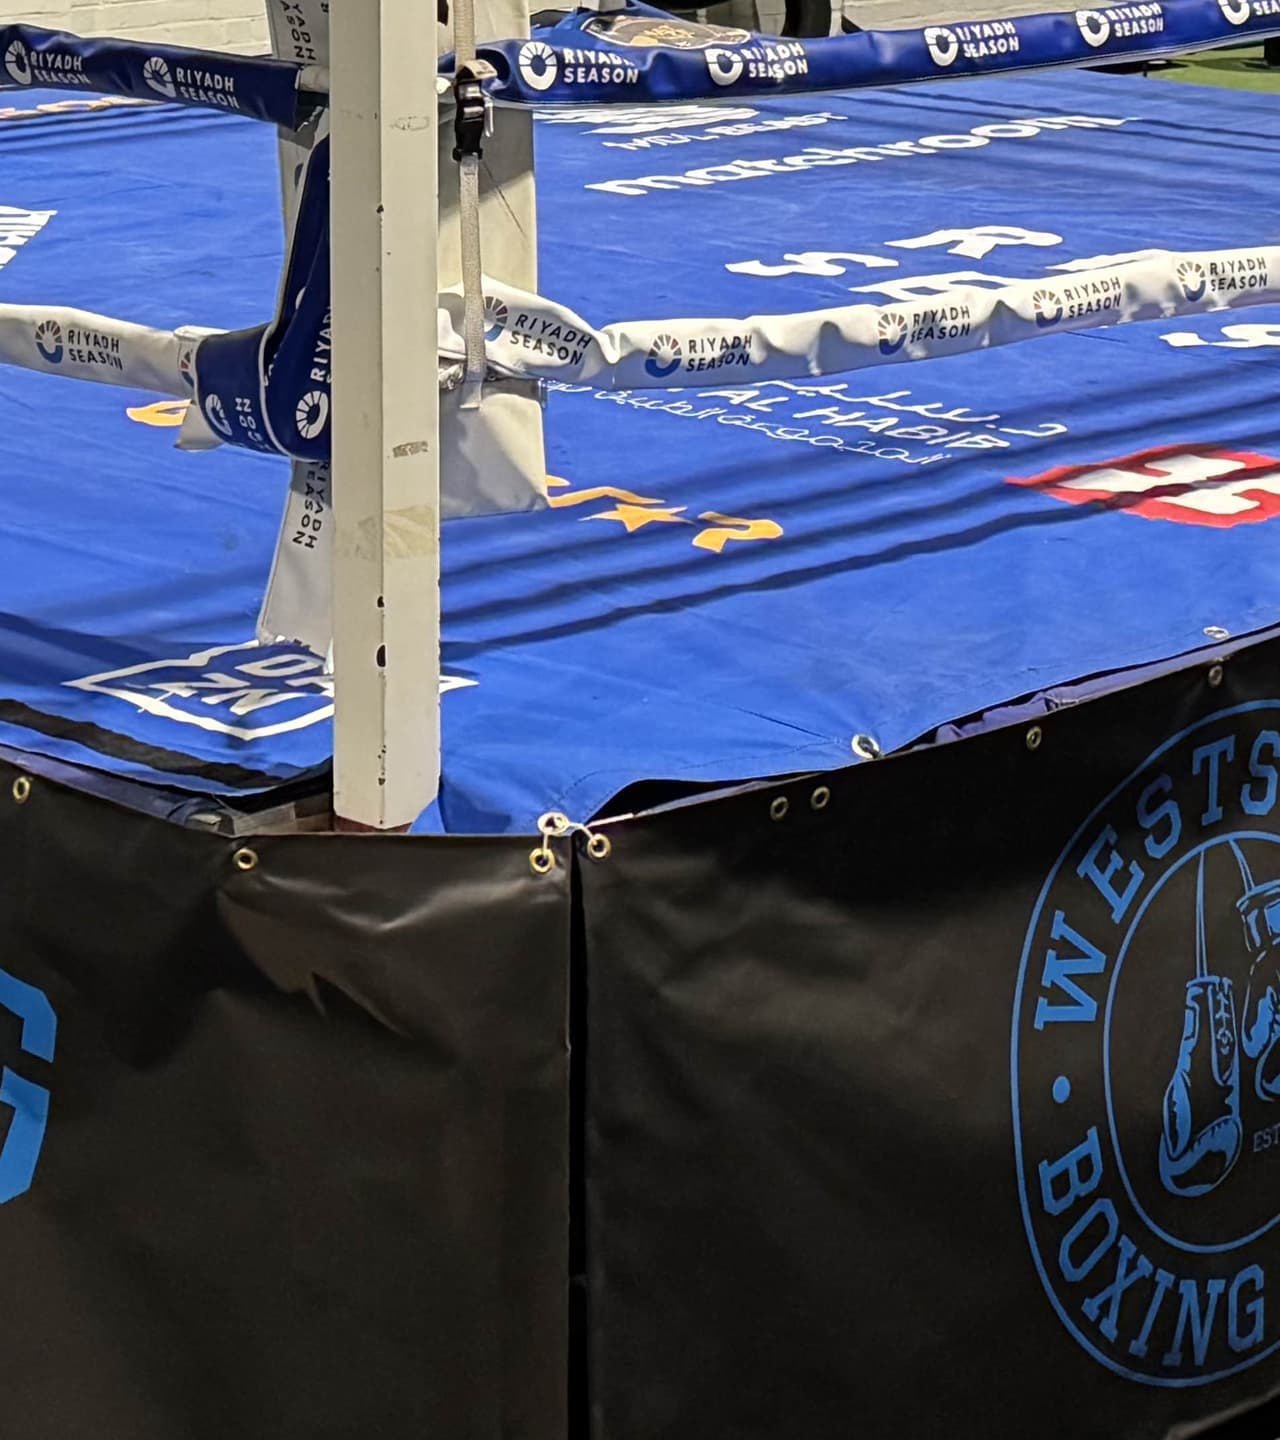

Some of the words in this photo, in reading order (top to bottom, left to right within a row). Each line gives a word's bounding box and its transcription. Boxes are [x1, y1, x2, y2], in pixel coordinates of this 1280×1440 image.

[1107, 2, 1162, 22] RIYADH
[957, 21, 1016, 42] RIYADH
[1115, 17, 1163, 37] SEASON
[963, 36, 1019, 58] SEASON
[177, 67, 235, 92] RIYADH
[564, 67, 638, 84] SEASON
[749, 60, 808, 78] SEASON
[179, 86, 238, 109] SEASON
[584, 116, 1142, 195] matchroom
[1210, 257, 1266, 278] RIYADH
[1063, 276, 1121, 302] RIYADH
[1211, 273, 1267, 293] SEASON
[912, 306, 969, 328] RIYADH
[1069, 294, 1121, 318] SEASON
[68, 330, 119, 353] RIYADH
[515, 313, 593, 349] RIYADH
[911, 323, 970, 343] SEASON
[510, 330, 583, 365] SEASON
[689, 335, 752, 354] RIYADH
[687, 353, 750, 373] SEASON
[697, 389, 788, 412] AL
[793, 406, 1011, 449] HABIB
[1039, 1126, 1265, 1367] BOXING
